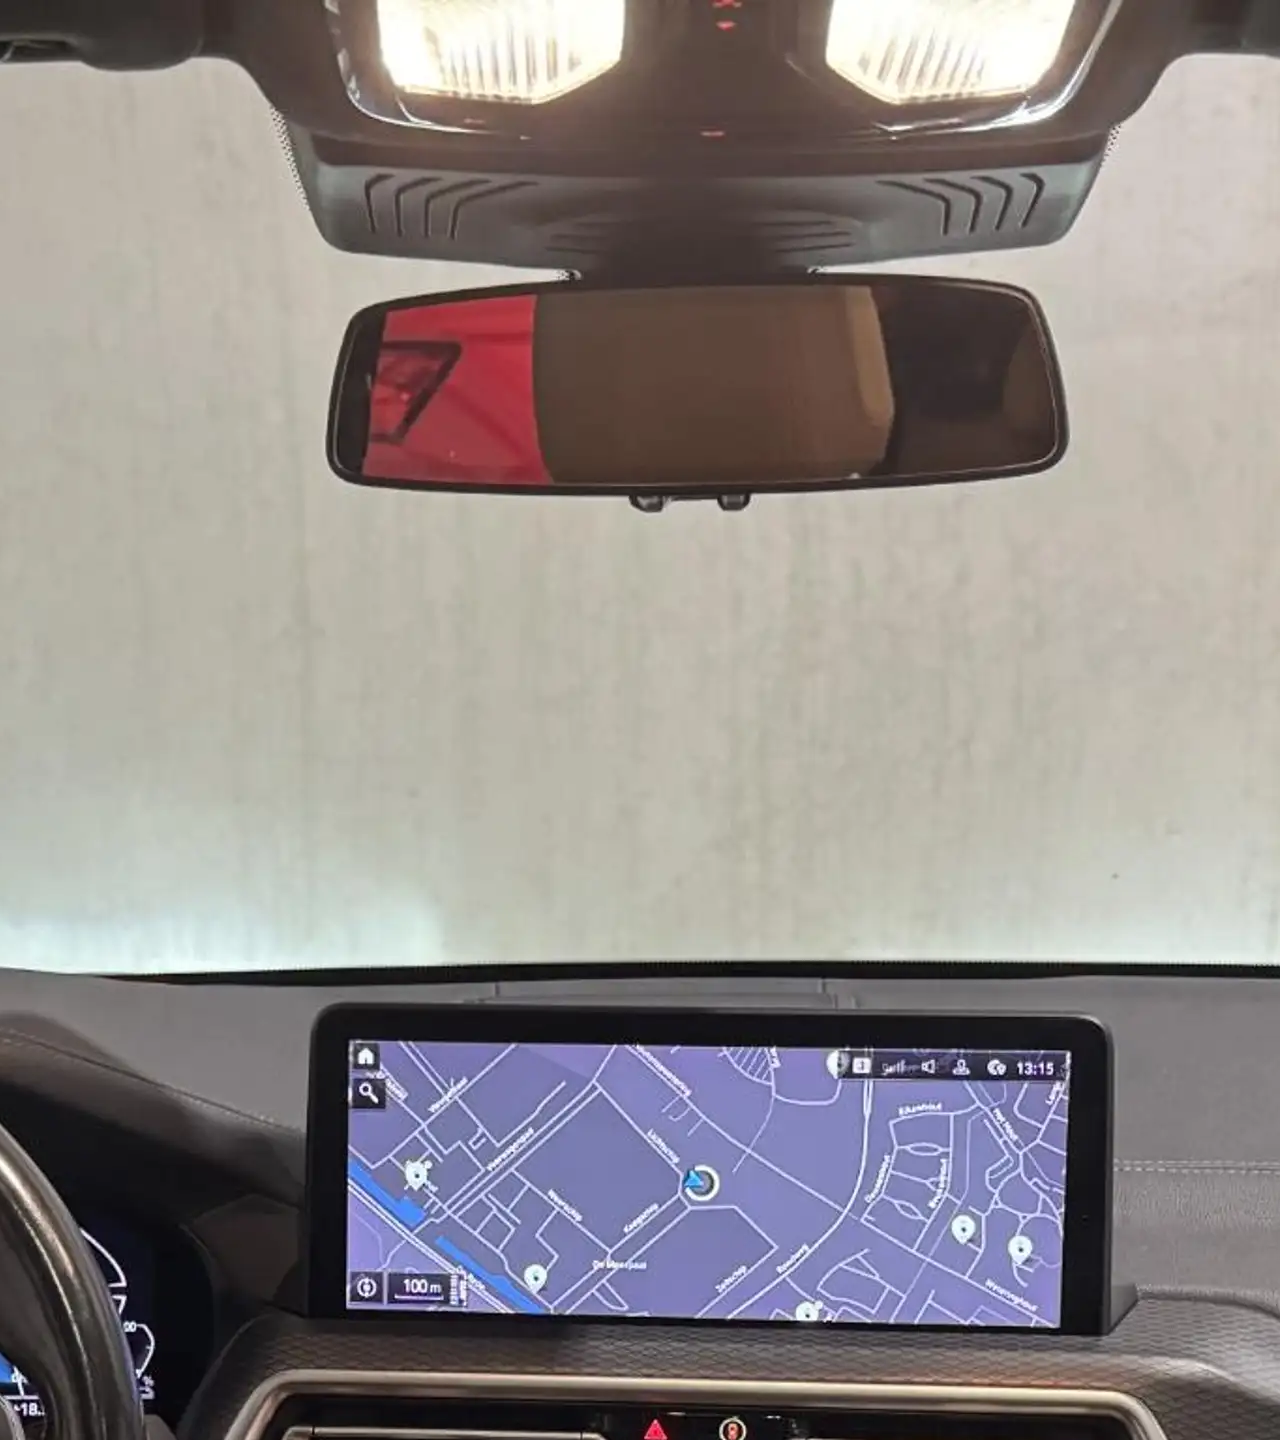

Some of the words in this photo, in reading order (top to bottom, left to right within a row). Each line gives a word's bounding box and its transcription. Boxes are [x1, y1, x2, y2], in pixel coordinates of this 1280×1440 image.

[1016, 1061, 1054, 1076] 13:15
[403, 1279, 428, 1293] 100
[430, 1283, 441, 1293] m
